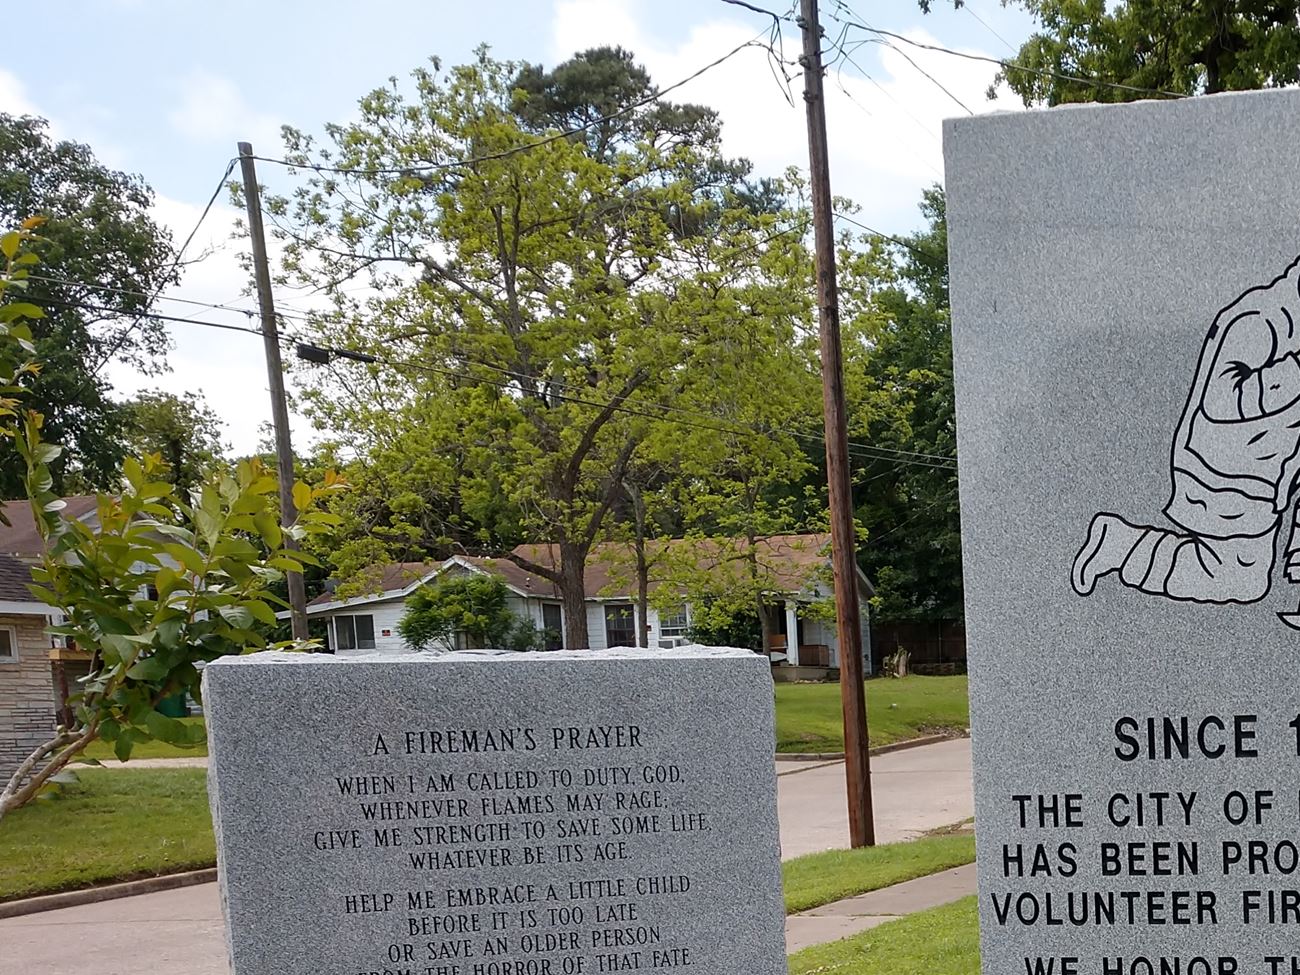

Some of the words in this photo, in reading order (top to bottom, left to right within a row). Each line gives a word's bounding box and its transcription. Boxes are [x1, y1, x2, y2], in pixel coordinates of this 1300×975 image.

[373, 733, 390, 756] A
[405, 727, 537, 755] FIREMAN'S
[552, 725, 643, 750] PRAYER
[1114, 714, 1259, 762] SINCE
[335, 775, 395, 796] WHEN
[408, 775, 415, 794] I
[426, 773, 456, 793] AM
[466, 770, 539, 792] CALLED
[549, 768, 572, 788] TO
[1011, 793, 1084, 829] THE
[1107, 791, 1197, 828] CITY
[1222, 789, 1274, 826] OF
[408, 848, 513, 870] WHATEVER
[523, 846, 547, 865] BE
[556, 843, 584, 863] ITS
[1002, 841, 1078, 878] HAS
[1100, 841, 1199, 877] BEEN
[345, 892, 394, 914] HELP
[407, 890, 437, 910] ME
[446, 884, 536, 908] EMBRACE
[545, 884, 559, 901] A
[568, 878, 627, 900] LITTLE
[636, 875, 691, 896] CHILD
[990, 890, 1218, 927] VOLUNTEER
[407, 913, 482, 937] BEFORE
[492, 911, 509, 930] IT
[520, 909, 537, 929] IS
[548, 906, 584, 926] TOO
[595, 902, 639, 923] LATE
[387, 943, 415, 963] OR
[426, 939, 475, 961] SAVE
[483, 937, 508, 956] AN
[520, 931, 581, 954] OLDER
[591, 926, 660, 948] PERSON
[562, 956, 585, 975] OF
[593, 951, 642, 972] THAT
